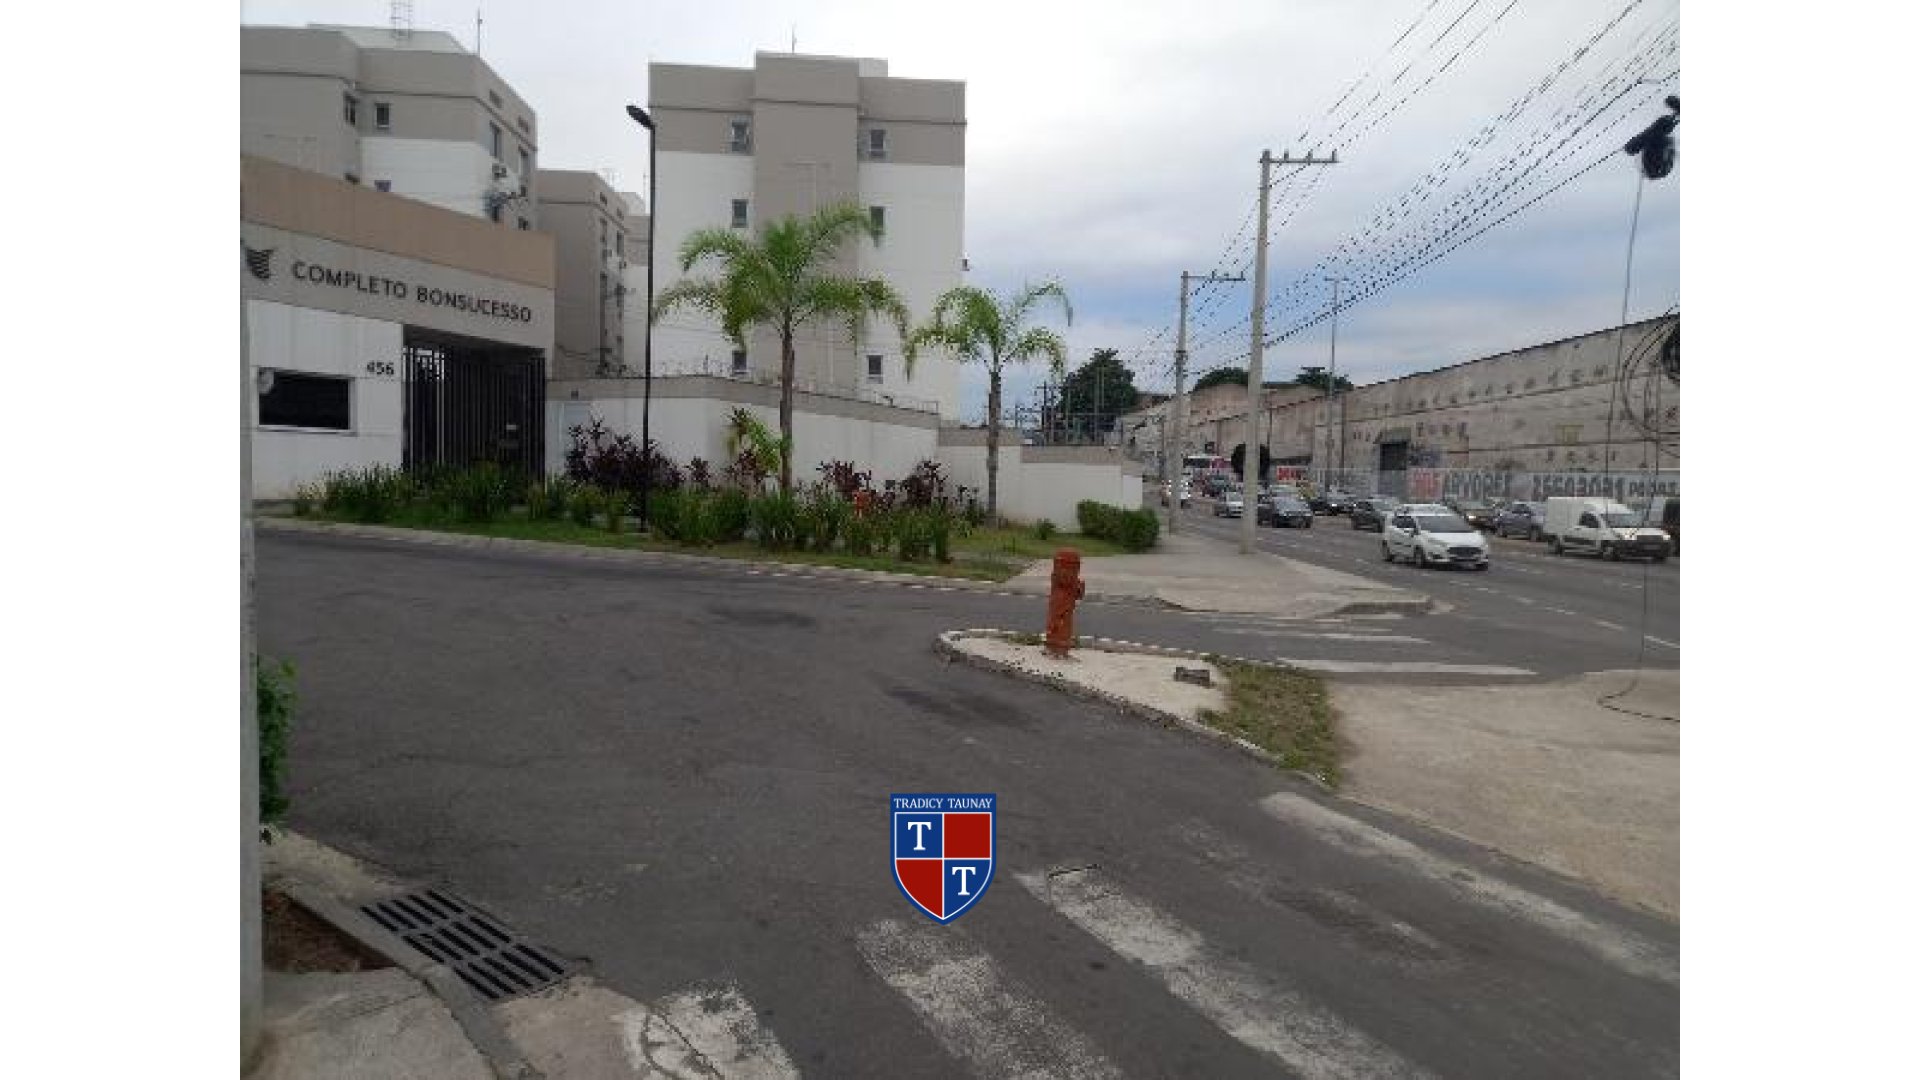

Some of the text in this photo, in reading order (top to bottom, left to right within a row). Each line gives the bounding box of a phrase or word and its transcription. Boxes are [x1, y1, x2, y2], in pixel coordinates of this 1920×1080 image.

[291, 260, 532, 323] COMPLETO BONSUCESSO
[366, 360, 395, 377] 456
